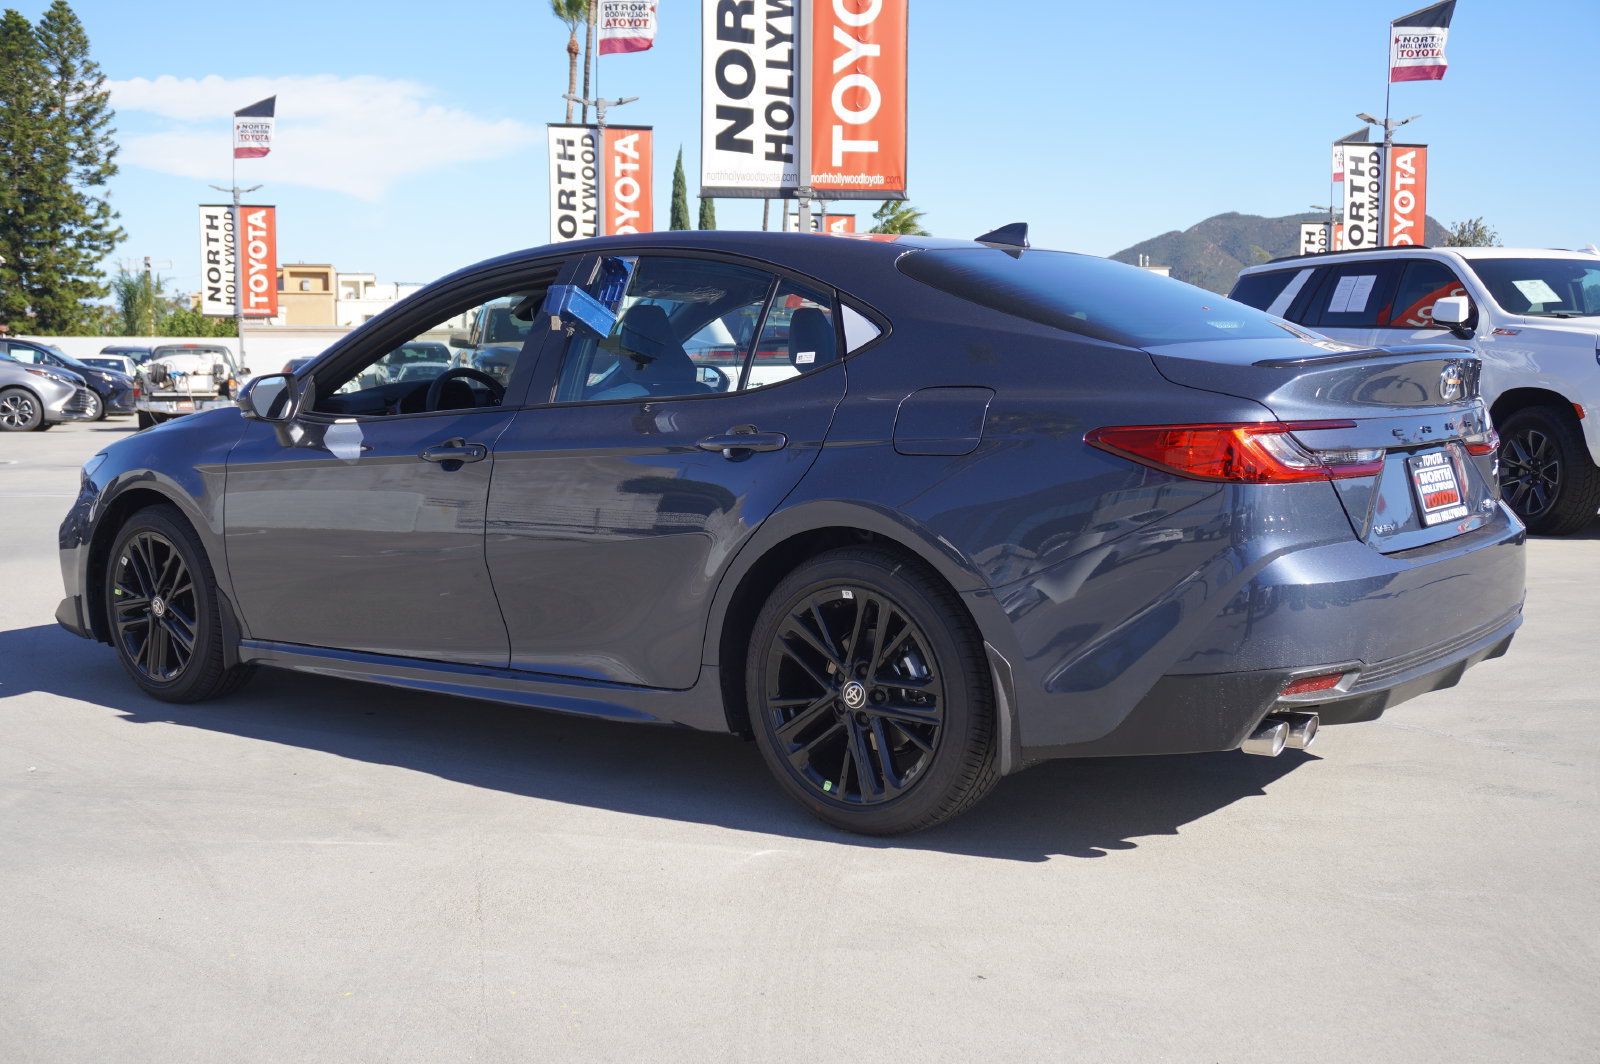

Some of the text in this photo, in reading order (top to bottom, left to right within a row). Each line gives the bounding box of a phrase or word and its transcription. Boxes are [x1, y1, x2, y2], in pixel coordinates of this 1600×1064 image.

[1400, 49, 1442, 58] TOYOTA
[556, 138, 577, 242] ORTH
[1348, 155, 1365, 247] ORTH
[206, 214, 221, 302] NORTH
[224, 211, 236, 306] HOLLYWOOD
[247, 209, 268, 307] TOYOTA
[1420, 468, 1452, 485] NORTH
[1422, 452, 1443, 466] TOYOTA
[1421, 480, 1454, 494] HOLLYWOOD
[1424, 489, 1459, 508] TOYOTA
